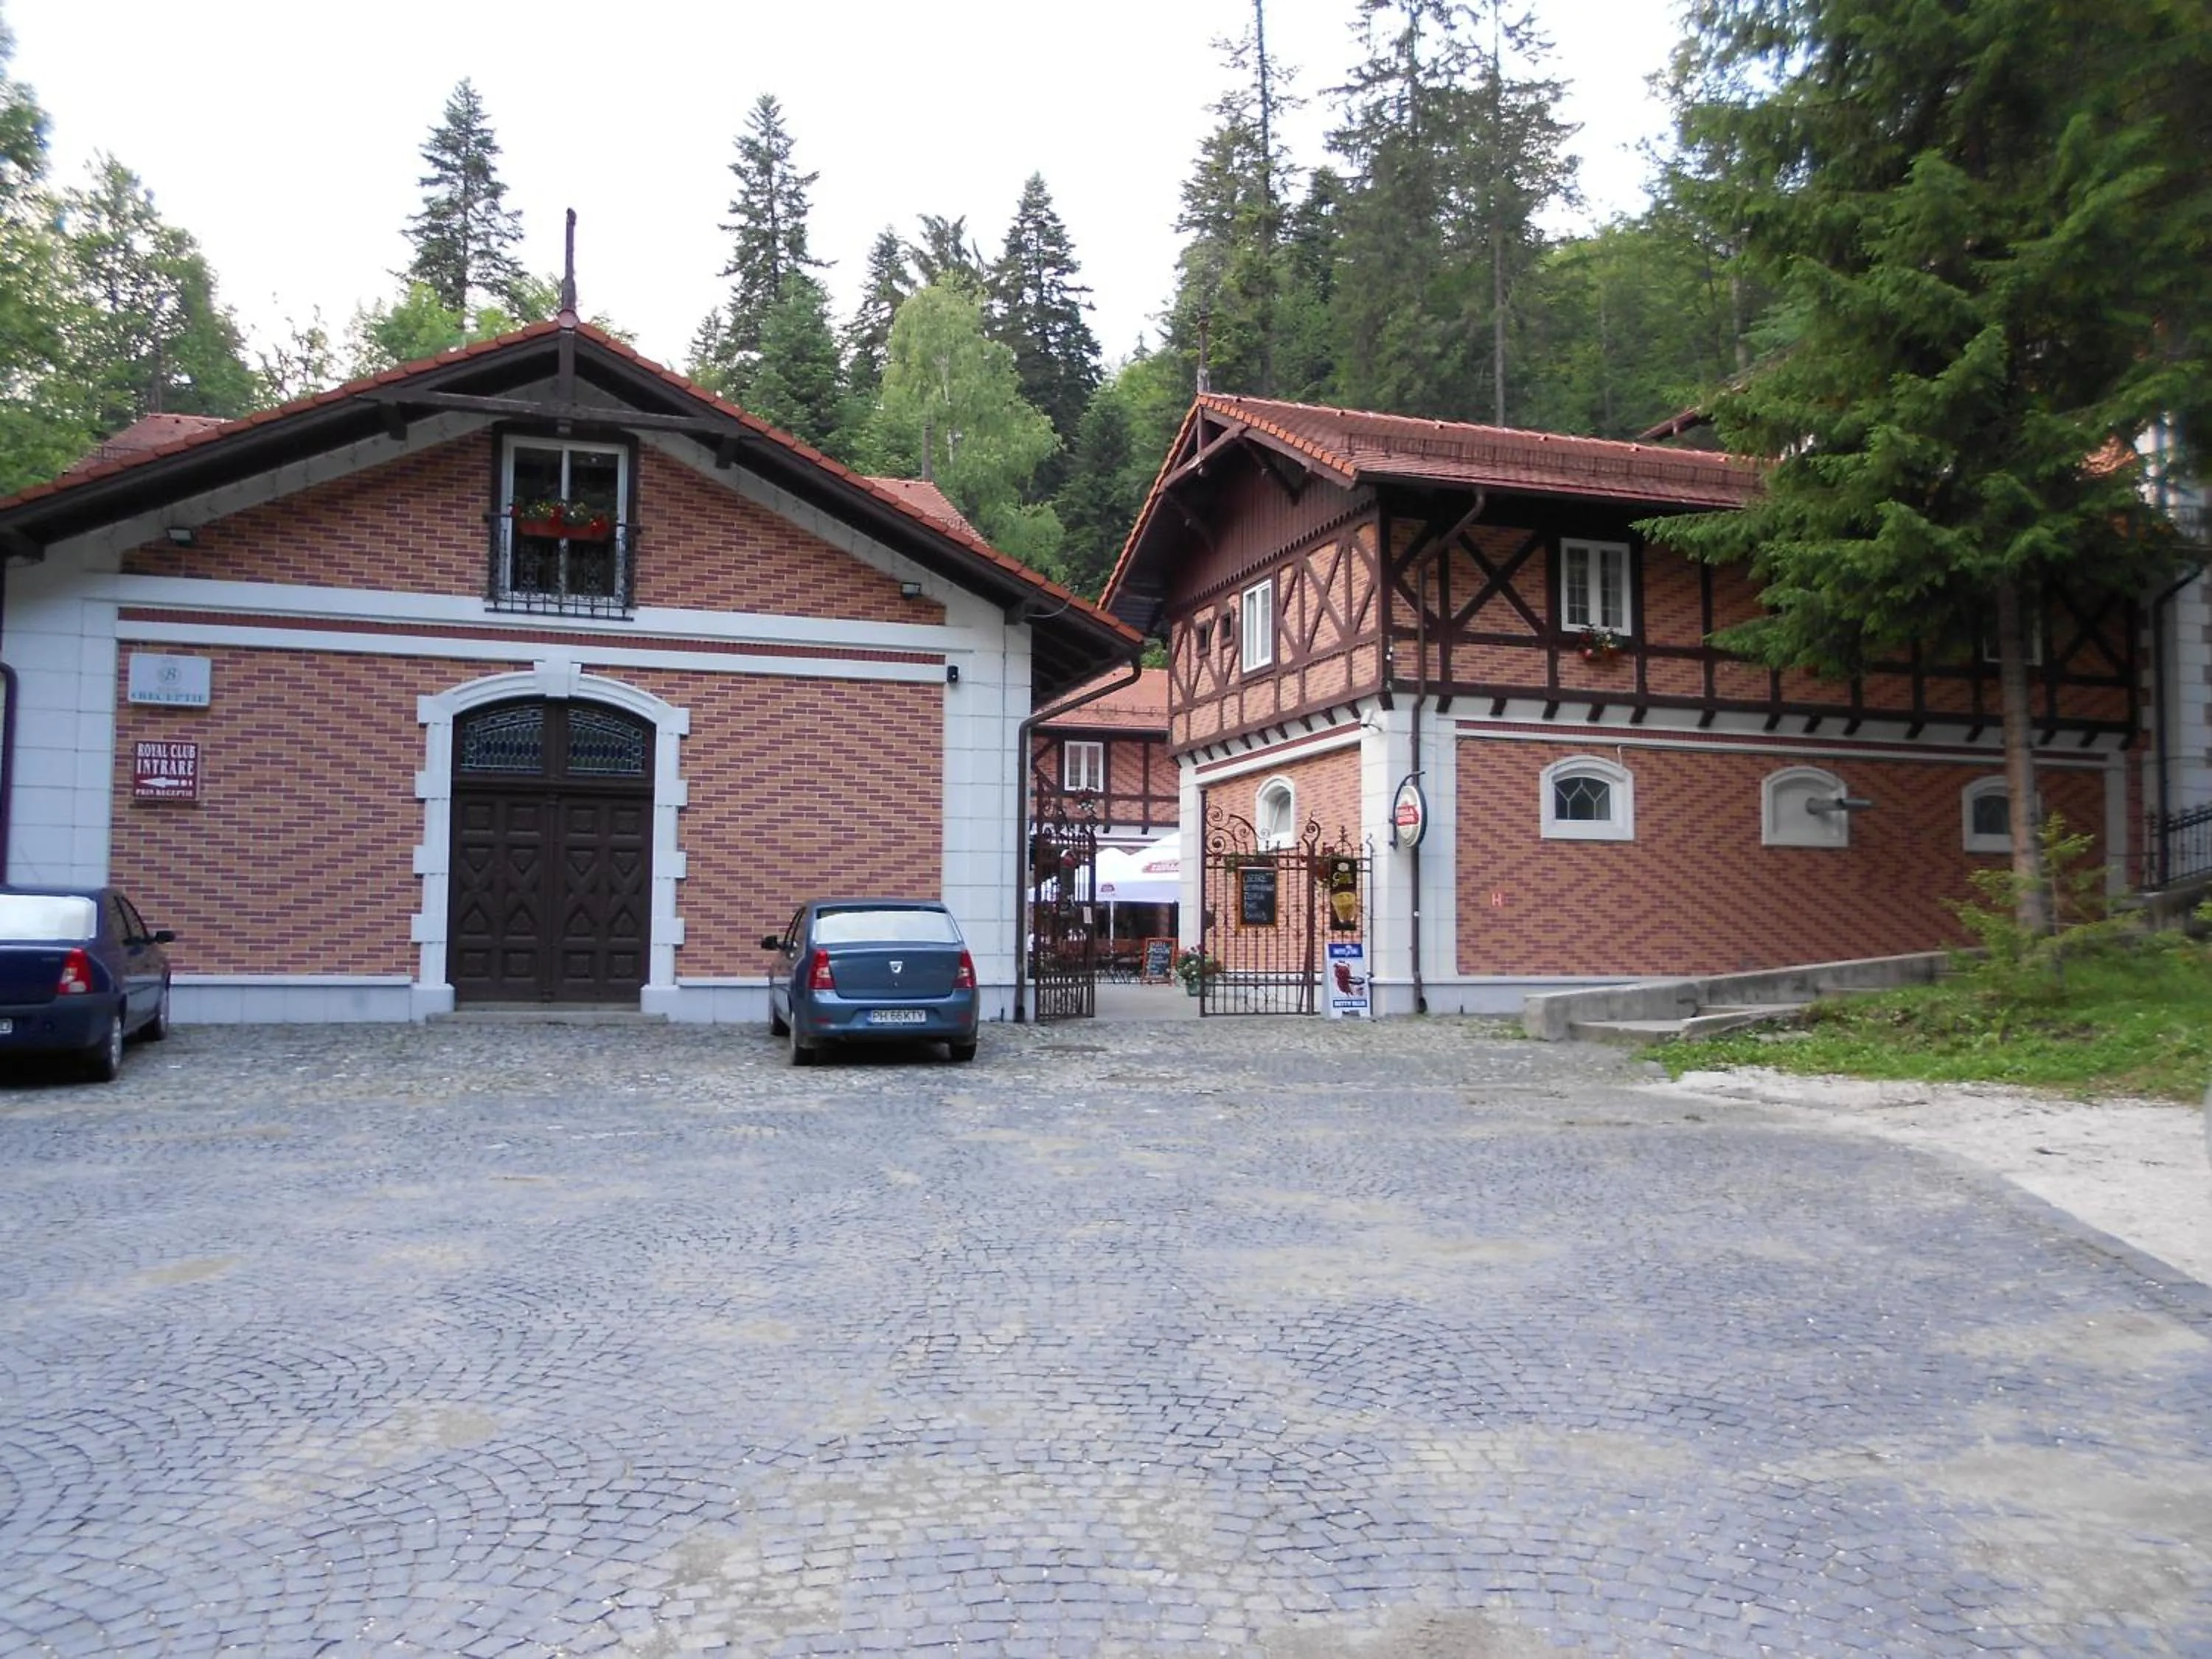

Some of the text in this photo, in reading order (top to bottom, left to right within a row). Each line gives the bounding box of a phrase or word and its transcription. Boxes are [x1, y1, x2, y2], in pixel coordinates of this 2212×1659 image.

[137, 742, 195, 759] ROYAL CLUB
[136, 759, 195, 776] INTRARE
